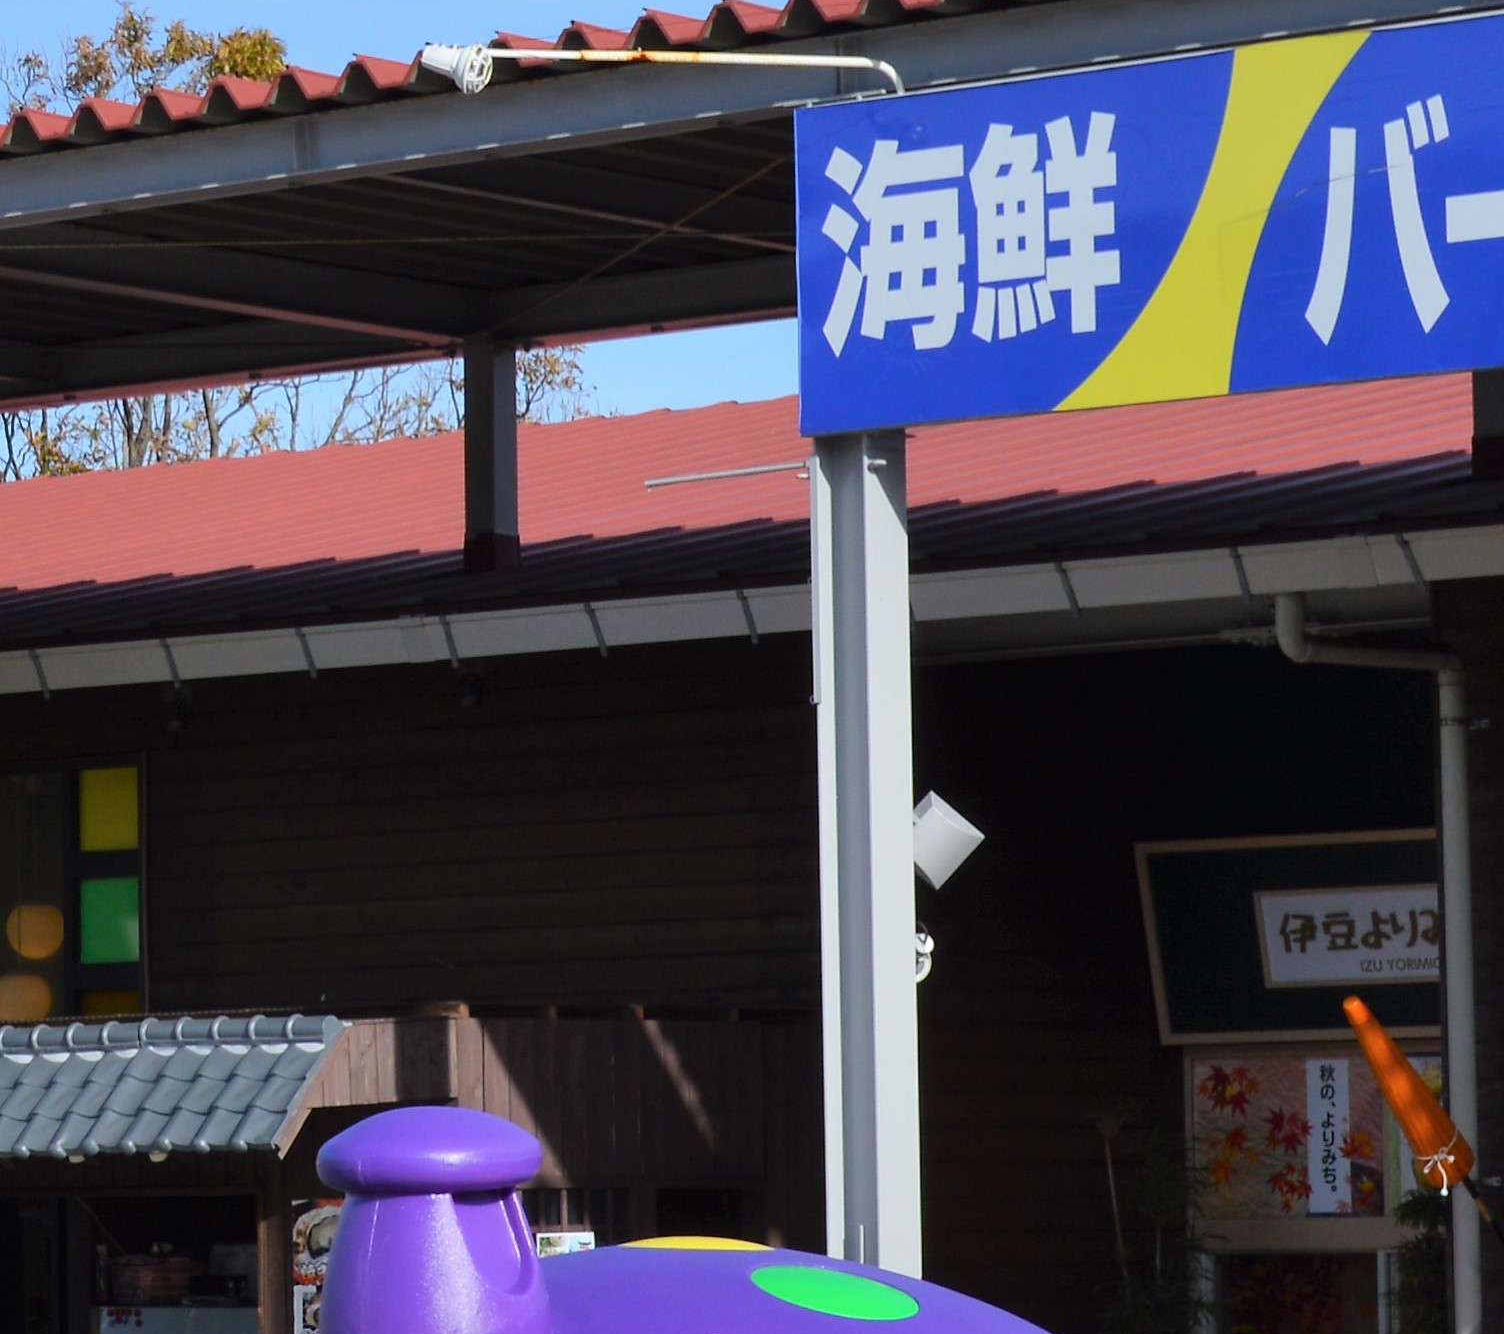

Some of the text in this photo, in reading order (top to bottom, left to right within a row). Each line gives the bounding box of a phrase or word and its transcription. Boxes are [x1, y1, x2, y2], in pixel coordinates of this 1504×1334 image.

[821, 110, 1121, 359] 海鮮
[1361, 960, 1381, 972] IZU
[1320, 1064, 1337, 1192] 秋の、よりみち。
